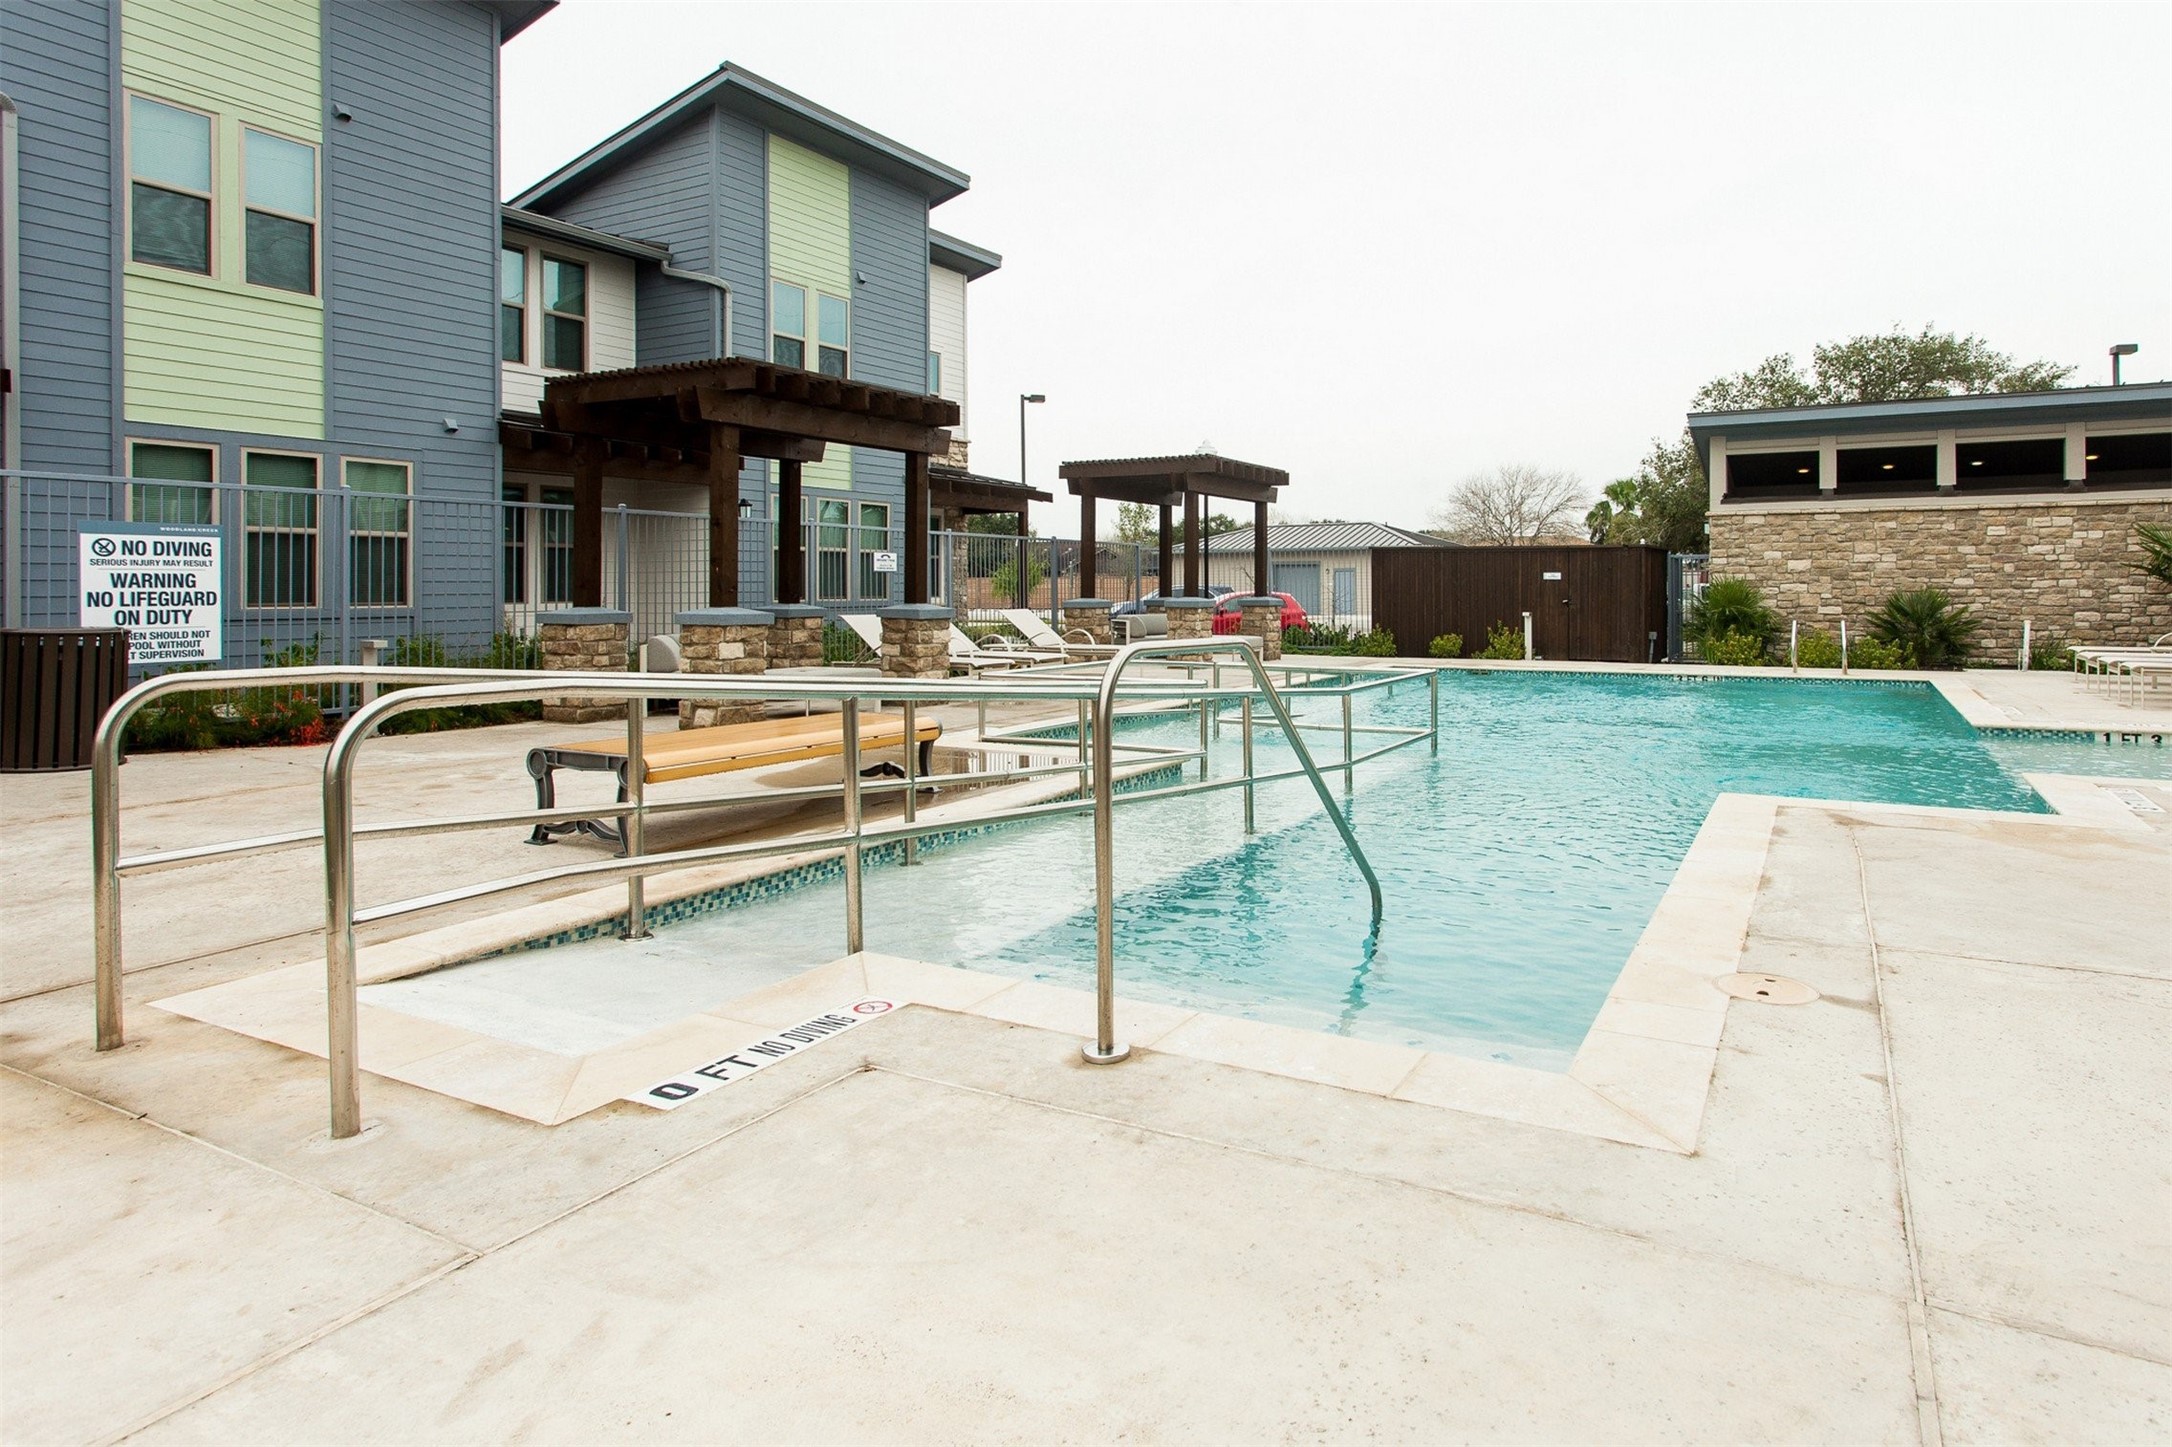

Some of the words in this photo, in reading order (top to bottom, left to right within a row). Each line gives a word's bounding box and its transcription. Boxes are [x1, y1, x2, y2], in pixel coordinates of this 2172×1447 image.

[121, 540, 147, 556] NO
[153, 541, 212, 557] DIVING
[90, 558, 128, 566] SERIOUS
[130, 559, 160, 567] INJURY
[110, 573, 197, 588] WARNING
[87, 591, 113, 607] NO
[120, 591, 217, 607] LIFEGUARD
[114, 610, 140, 626] ON
[147, 609, 193, 625] DUTY
[149, 631, 189, 640] SHOULD
[191, 630, 211, 639] NOT
[129, 641, 155, 650] POOL
[157, 640, 202, 649] WITHOUT
[139, 649, 204, 659] SUPERVISION
[2121, 732, 2142, 743] FT
[695, 1054, 758, 1081] FT
[747, 1040, 796, 1057] NO
[779, 1014, 857, 1043] DIVING
